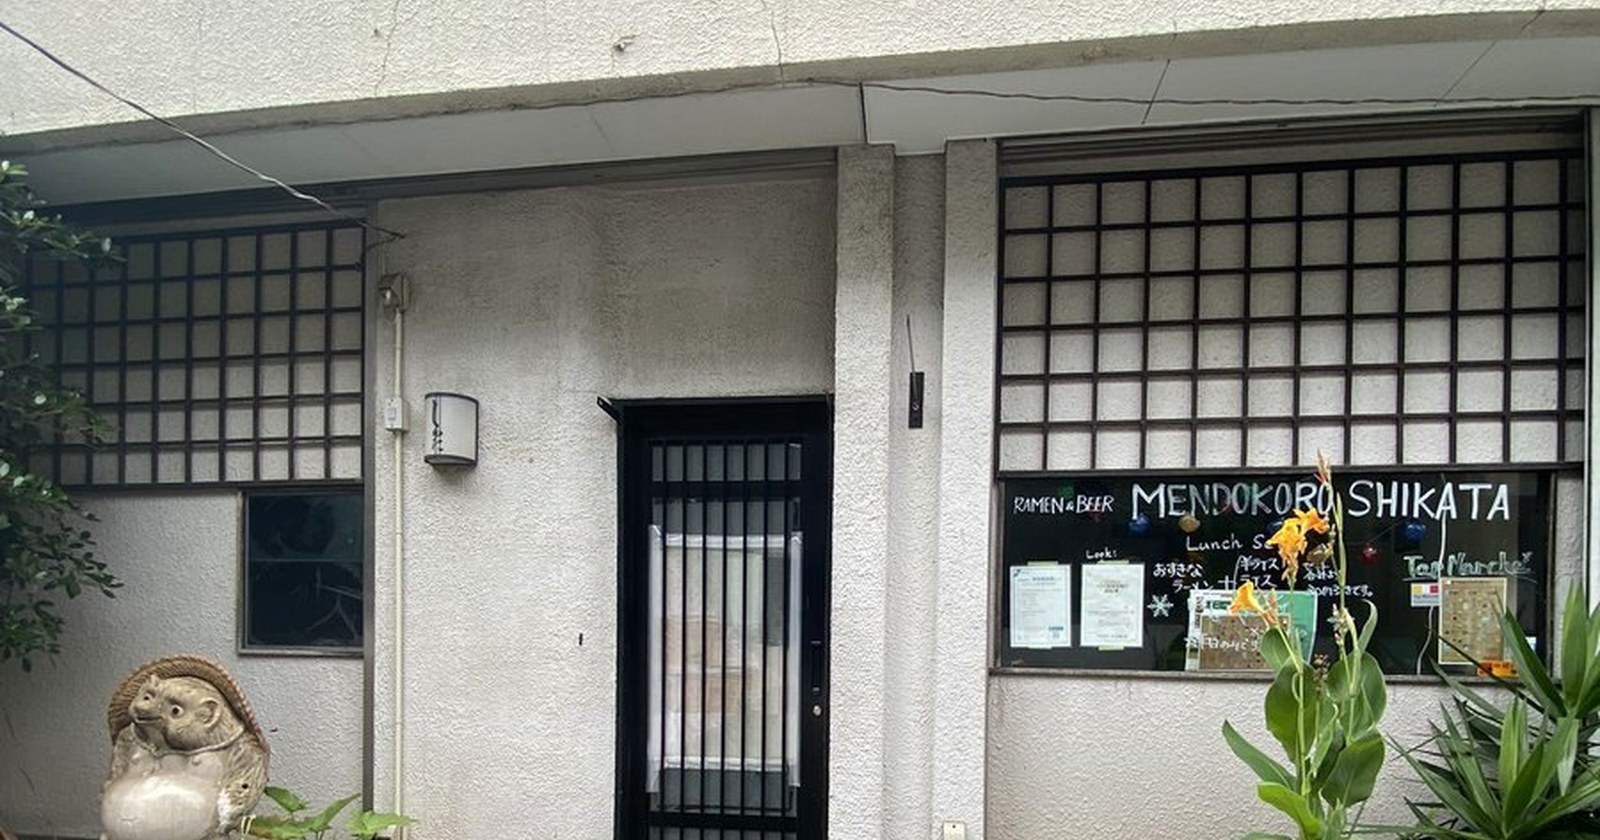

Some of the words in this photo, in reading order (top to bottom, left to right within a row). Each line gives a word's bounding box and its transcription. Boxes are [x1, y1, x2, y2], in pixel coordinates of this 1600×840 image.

[1013, 496, 1064, 515] RAMEN
[1075, 494, 1114, 514] BEER
[1132, 483, 1334, 520] MENDOKORO
[1348, 479, 1510, 521] SHIKATA
[1186, 532, 1243, 551] Lunch
